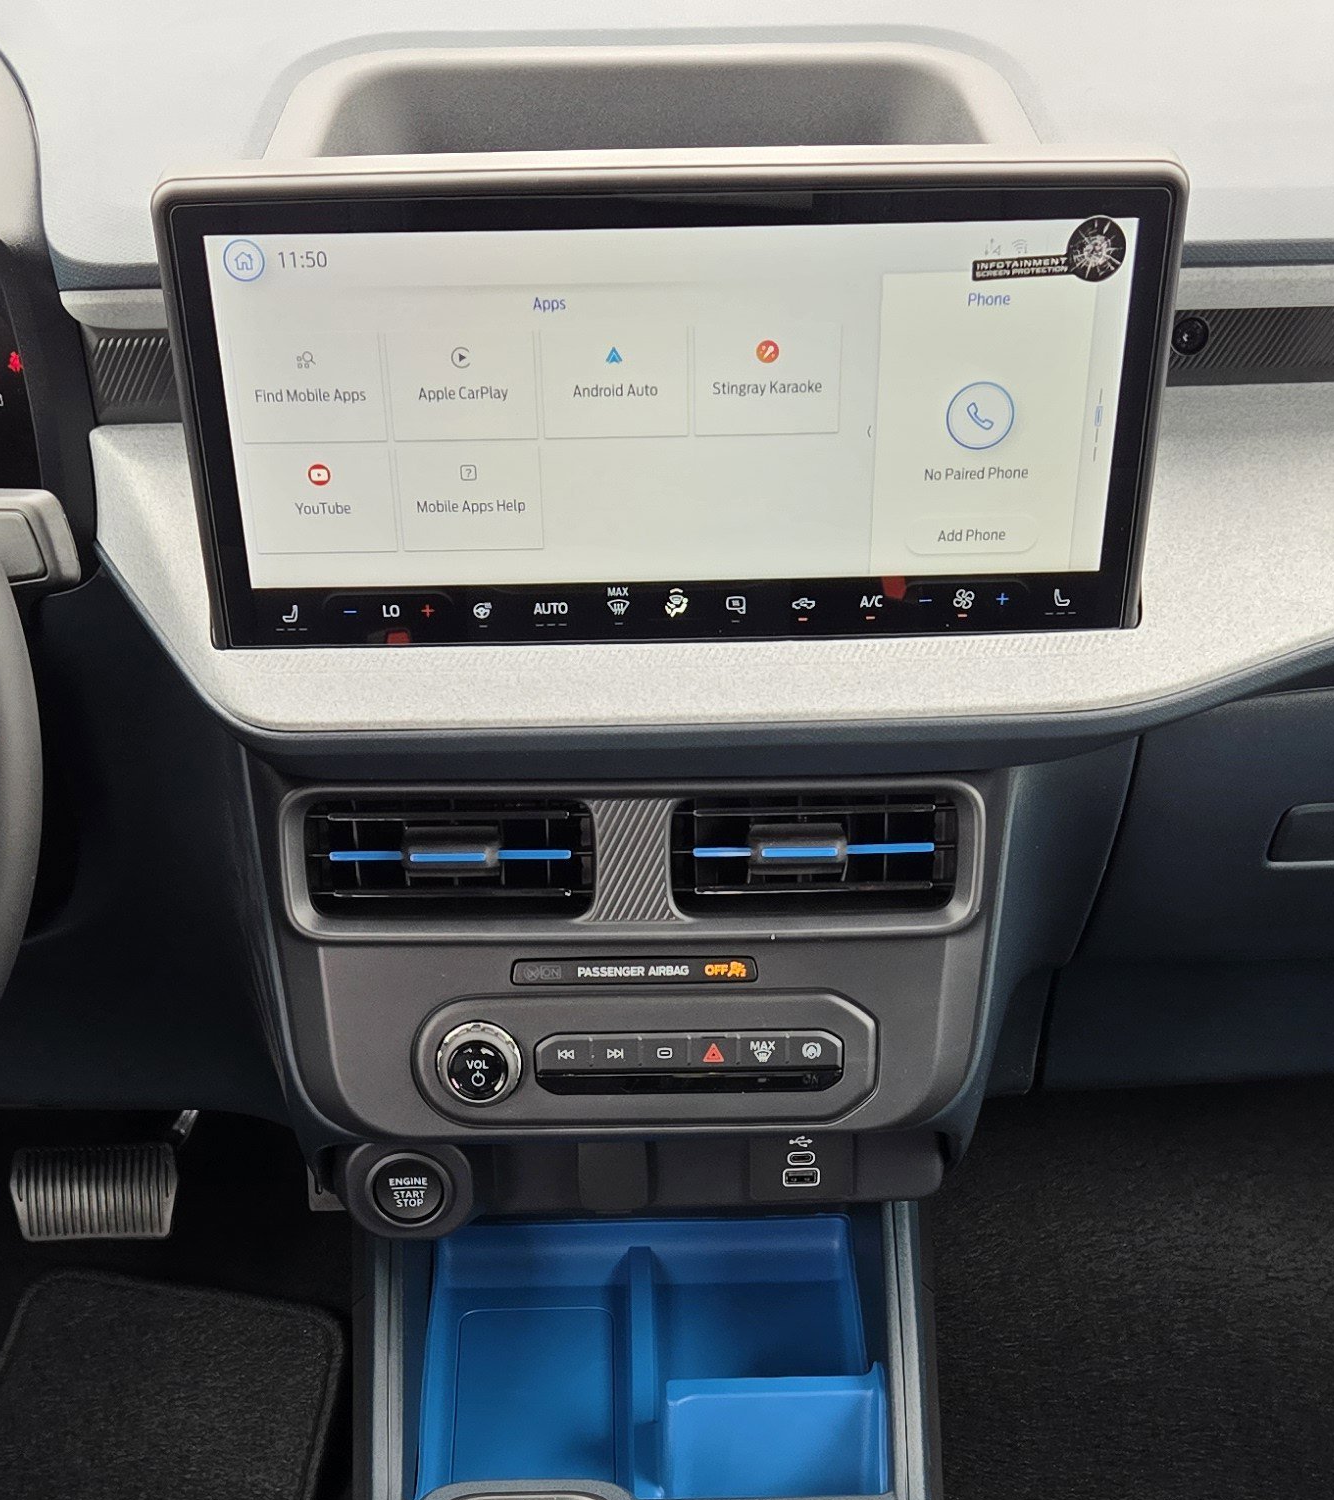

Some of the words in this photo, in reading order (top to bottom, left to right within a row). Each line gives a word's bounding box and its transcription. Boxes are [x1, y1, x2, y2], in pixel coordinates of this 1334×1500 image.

[278, 250, 328, 269] 11:50
[976, 257, 1068, 270] INFOTAINMENT
[975, 268, 1010, 278] SCREEN
[1011, 265, 1068, 276] PROTECTION
[533, 297, 566, 313] Apps
[968, 292, 1011, 306] Phone
[418, 387, 456, 402] Apple
[459, 386, 508, 401] CarPlay
[573, 383, 623, 398] Android
[627, 383, 658, 397] Auto
[712, 381, 766, 397] Stingray
[769, 380, 822, 394] Karaoke
[255, 389, 283, 402] Find
[286, 388, 330, 402] Mobile
[333, 388, 366, 404] Apps
[924, 468, 942, 481] No
[945, 467, 985, 480] Paired
[988, 466, 1029, 479] Phone
[294, 502, 351, 515] YouTube
[417, 500, 459, 513] Mobile
[462, 500, 494, 515] Apps
[497, 499, 526, 513] Help
[938, 529, 963, 542] Add
[966, 528, 1006, 541] Phone
[607, 586, 629, 597] MAX
[860, 595, 883, 608] A/C
[382, 604, 400, 618] LO
[534, 602, 568, 615] AUTO
[543, 967, 558, 978] ON
[577, 965, 645, 978] PASSENGER
[648, 965, 690, 977] AIRBAG
[704, 964, 728, 977] OFF
[749, 1040, 776, 1051] MAX
[466, 1060, 489, 1070] VOL
[388, 1177, 428, 1187] ENGINE
[393, 1190, 425, 1200] START
[396, 1199, 424, 1208] STOP
